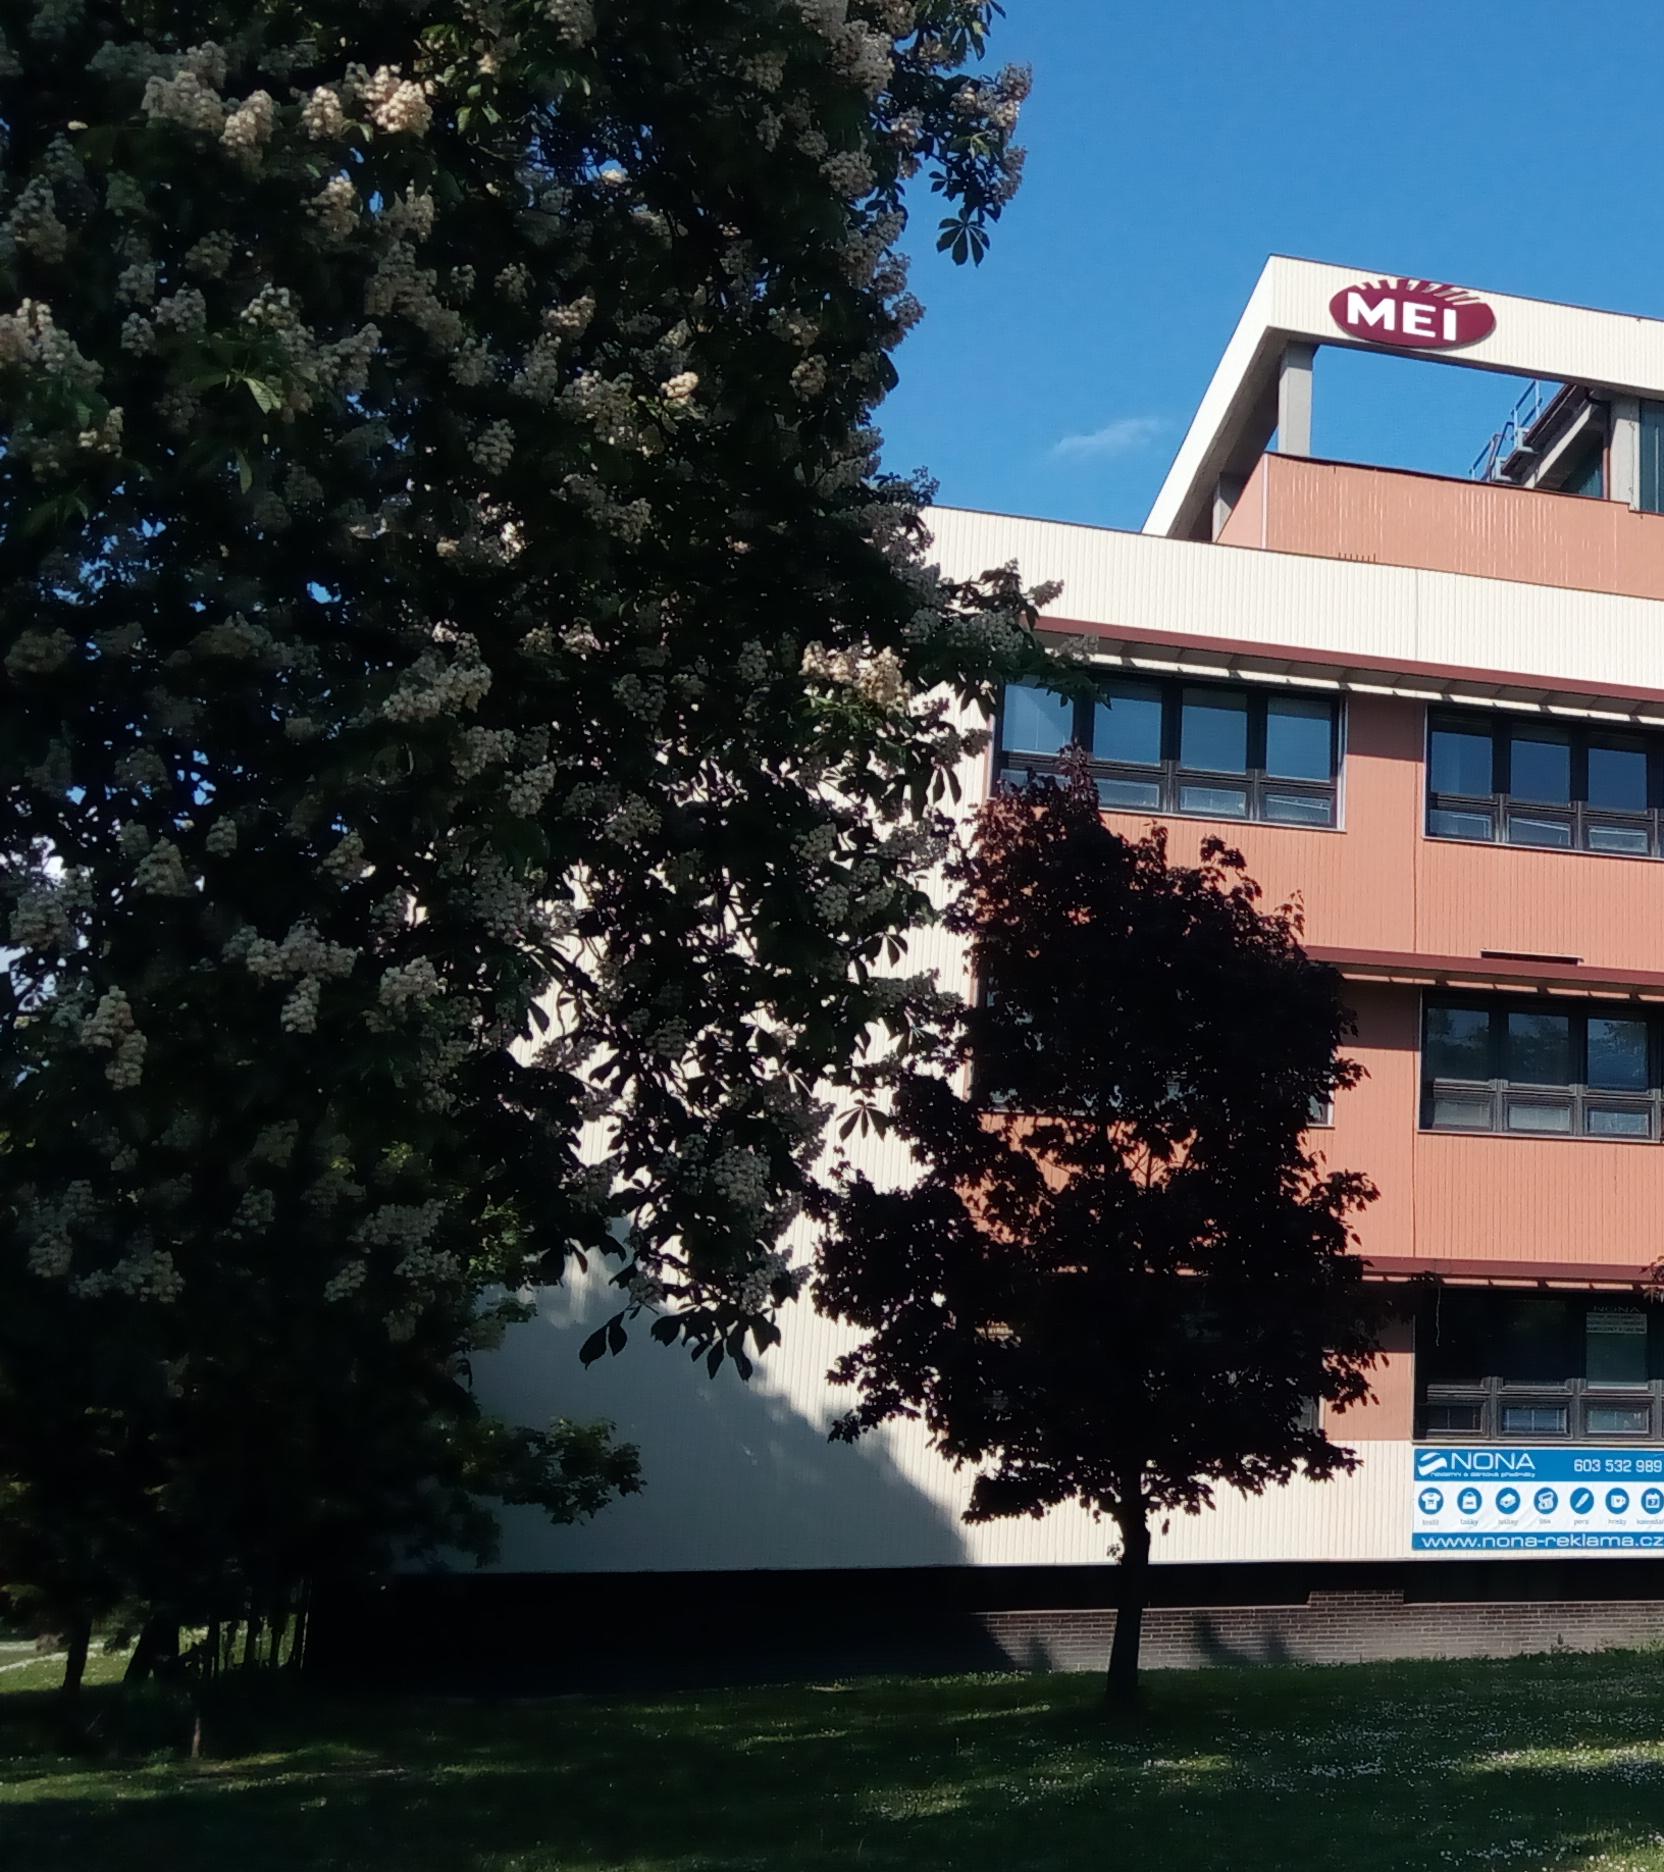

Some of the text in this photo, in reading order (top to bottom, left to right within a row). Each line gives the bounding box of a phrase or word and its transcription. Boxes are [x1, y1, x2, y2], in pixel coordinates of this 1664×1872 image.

[1347, 292, 1457, 341] MEI
[1451, 1452, 1536, 1470] NONA
[1574, 1459, 1663, 1473] 603 532 989
[1421, 1533, 1664, 1548] www.nona-reklama.cz
